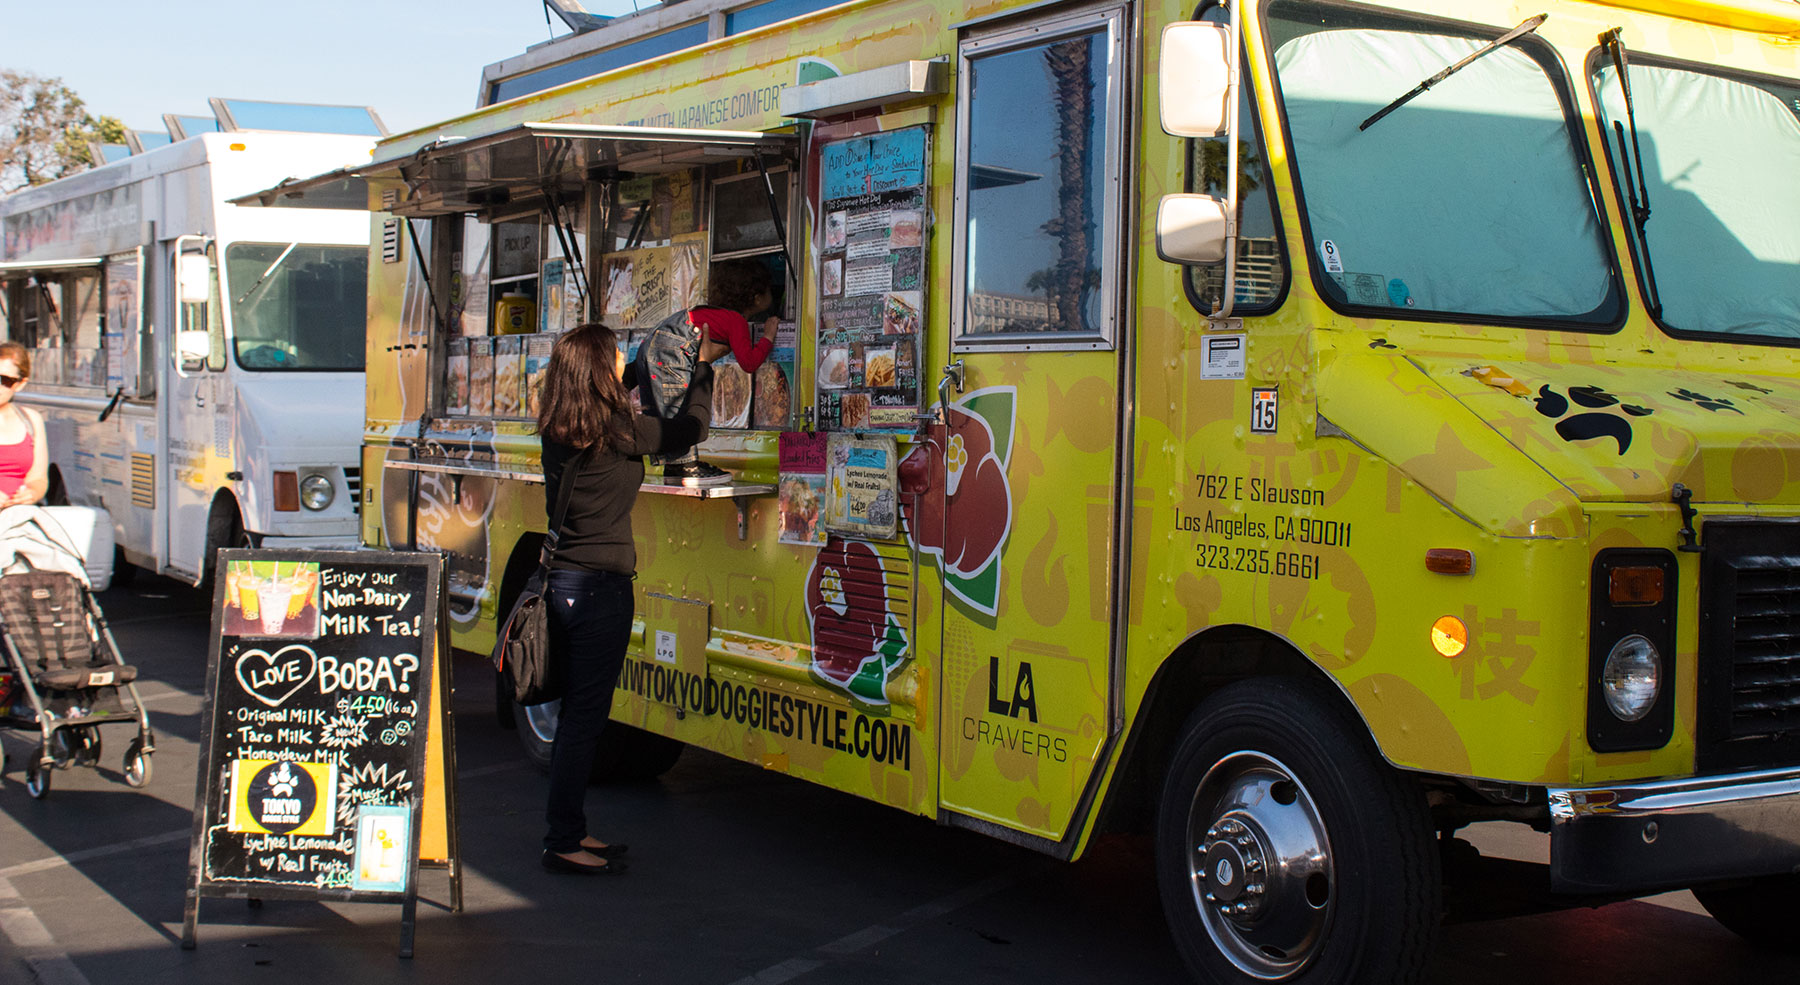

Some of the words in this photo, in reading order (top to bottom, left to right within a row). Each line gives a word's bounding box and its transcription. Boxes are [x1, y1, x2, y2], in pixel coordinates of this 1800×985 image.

[678, 97, 729, 129] JAPANESE
[731, 82, 787, 120] COMFOR
[1325, 241, 1334, 254] 6
[1255, 400, 1275, 429] 15
[847, 469, 862, 479] Lychee
[863, 471, 888, 480] Lemonade
[854, 481, 865, 489] Real
[1196, 474, 1228, 500] 762
[1234, 477, 1244, 501] E
[1250, 477, 1325, 507] Slauson
[1175, 507, 1201, 532] Los
[1204, 510, 1270, 541] Angeles,
[1274, 515, 1296, 541] CA
[1300, 518, 1352, 548] 90011
[1196, 543, 1320, 580] 323.235.6661
[320, 568, 367, 589] Enjoy
[322, 588, 412, 611] Non-Dairy
[374, 614, 421, 637] Tea!
[657, 648, 674, 659] LPG
[250, 659, 304, 690] LOVE
[317, 653, 420, 695] BOBA?
[988, 656, 1038, 724] LA
[236, 708, 287, 727] Original
[616, 657, 911, 771] WW.TOKYODOGGIESTYLE.COM
[237, 727, 275, 744] Taro
[963, 716, 1067, 763] CRAVERS
[238, 746, 312, 762] Honeydew
[261, 797, 302, 815] TOKYO
[243, 832, 288, 856] Lychee
[289, 831, 355, 855] Lemonade
[259, 855, 275, 871] w/
[277, 852, 305, 873] Real
